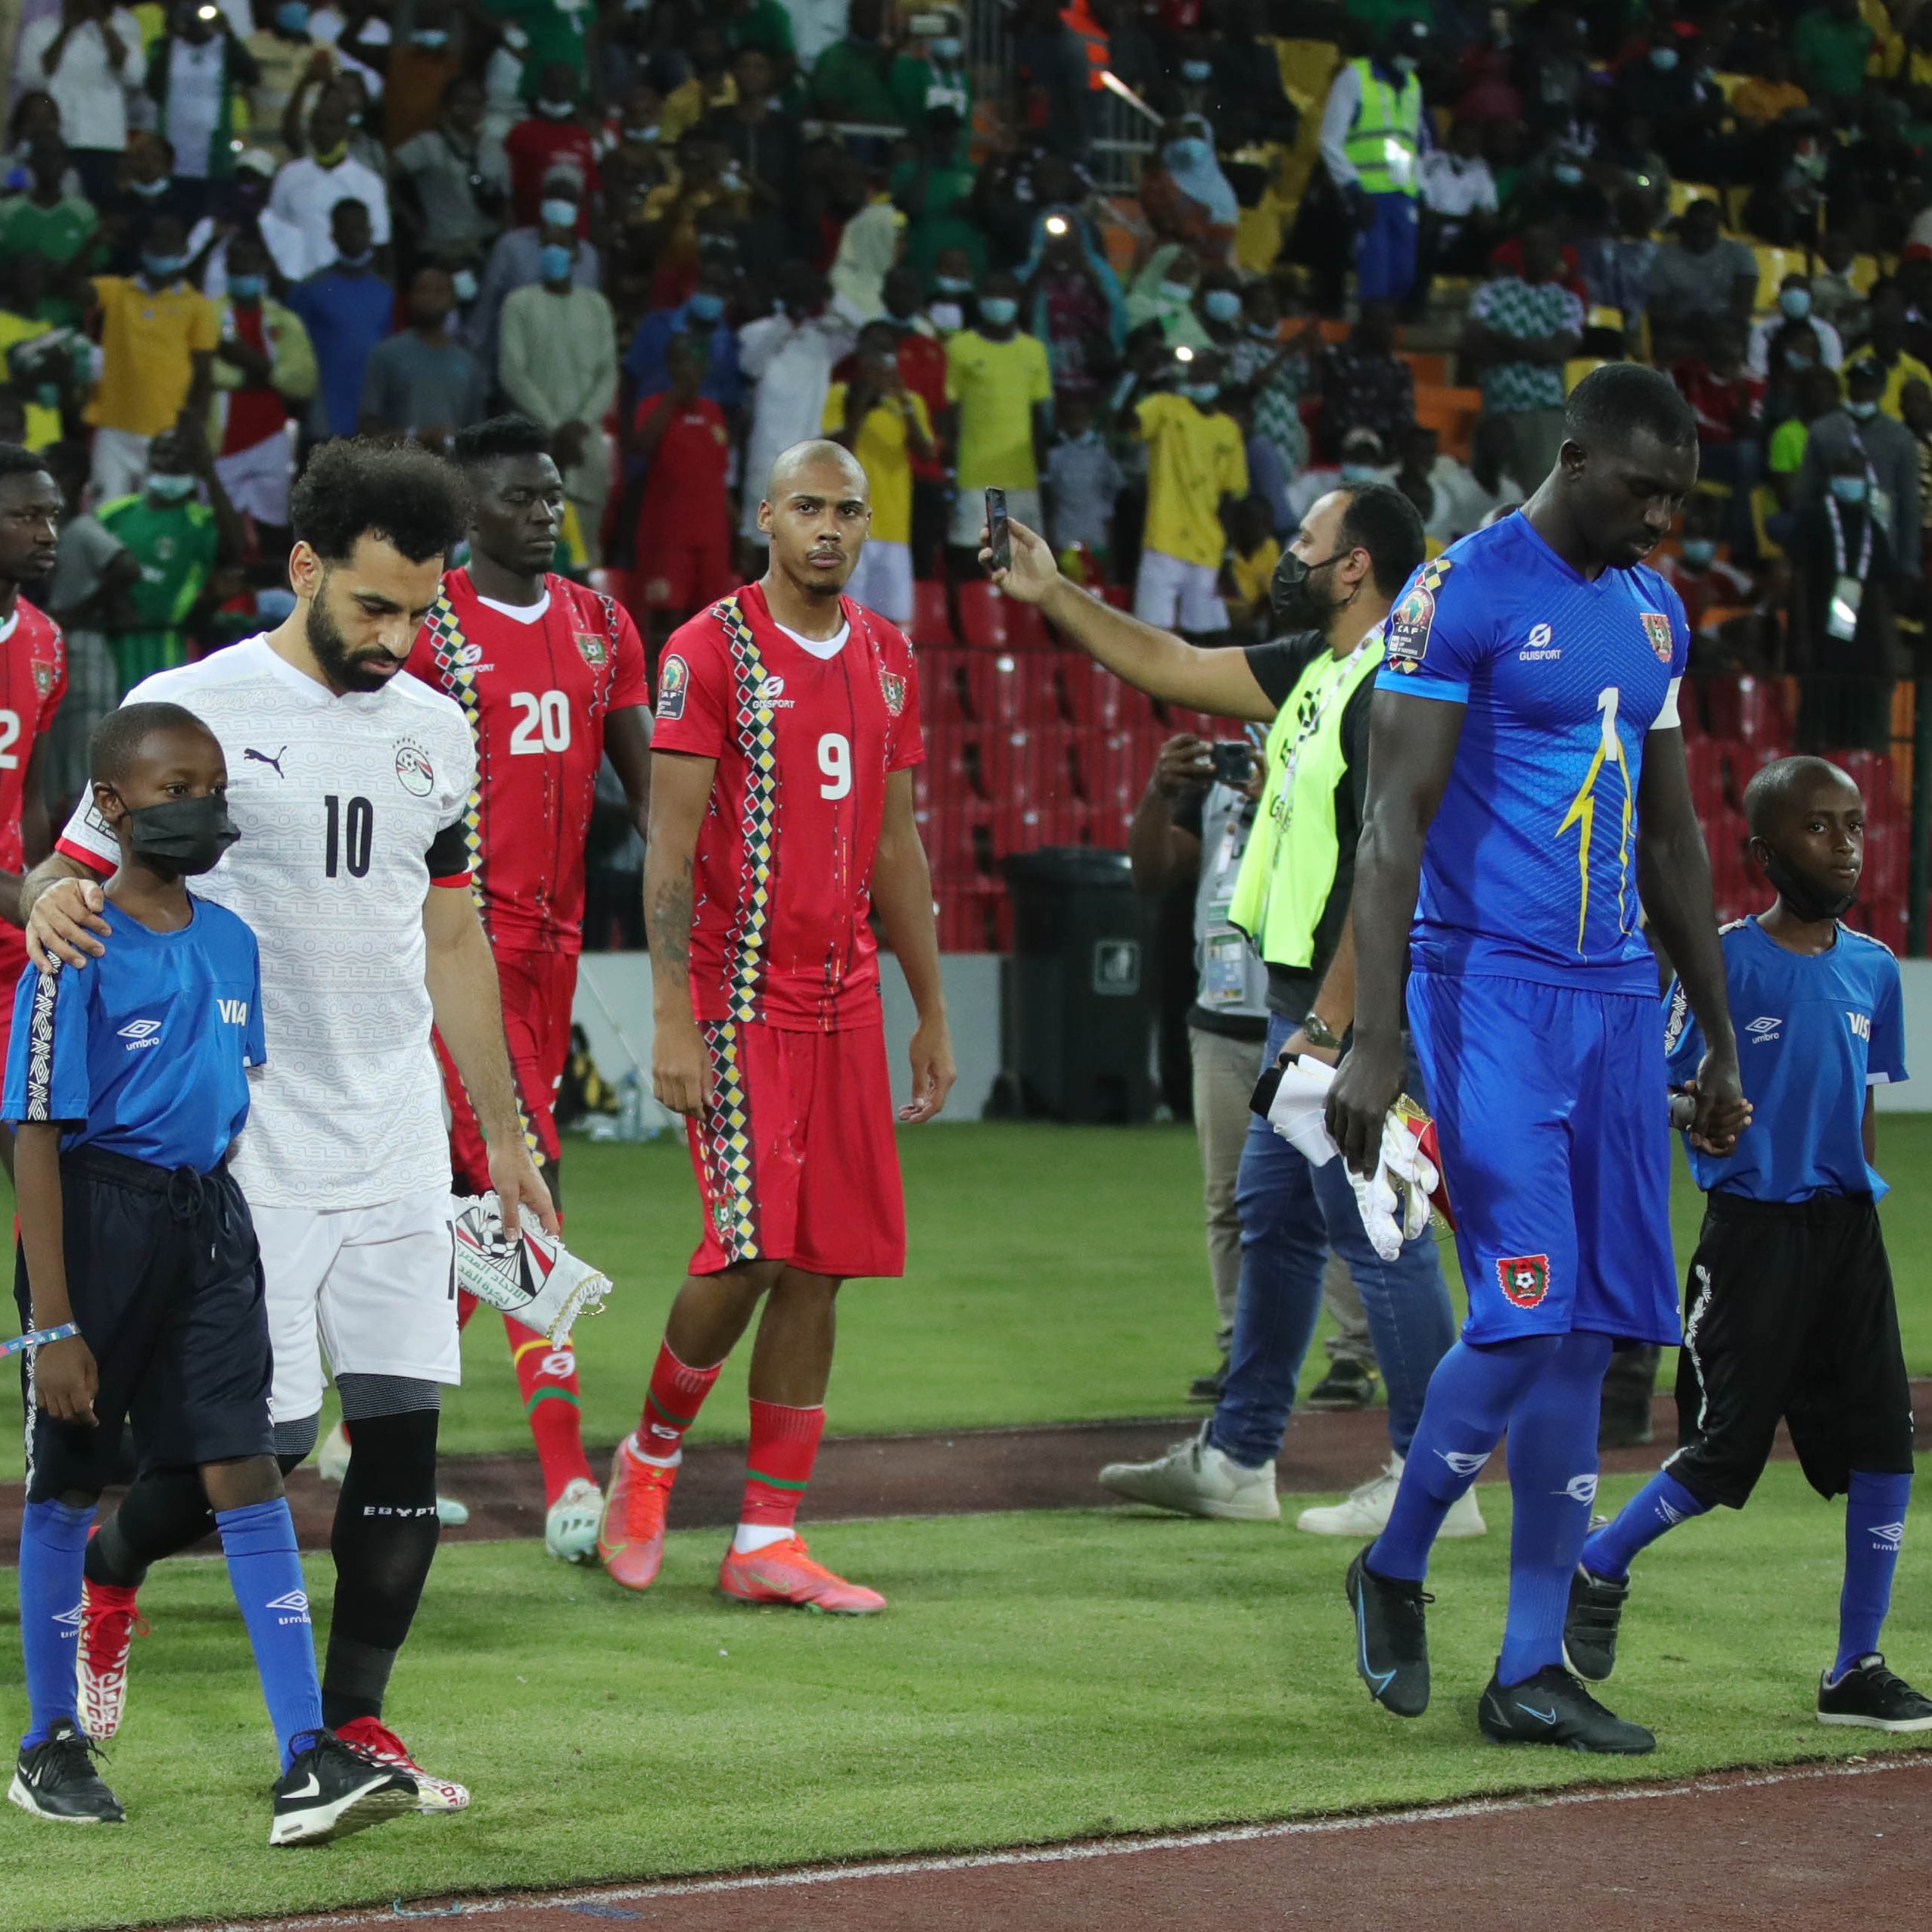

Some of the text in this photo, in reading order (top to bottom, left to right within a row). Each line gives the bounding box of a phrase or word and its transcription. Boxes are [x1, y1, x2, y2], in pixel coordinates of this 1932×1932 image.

[1520, 649, 1562, 661] GUISPORT
[510, 689, 571, 755] 20
[1597, 687, 1619, 761] 1
[817, 733, 852, 800] 9
[325, 795, 373, 878] 10
[217, 999, 247, 1026] VIA
[1846, 1011, 1871, 1043] VIS
[126, 1037, 160, 1051] umbro
[1752, 1032, 1780, 1044] umbro
[1872, 1542, 1899, 1551] umb
